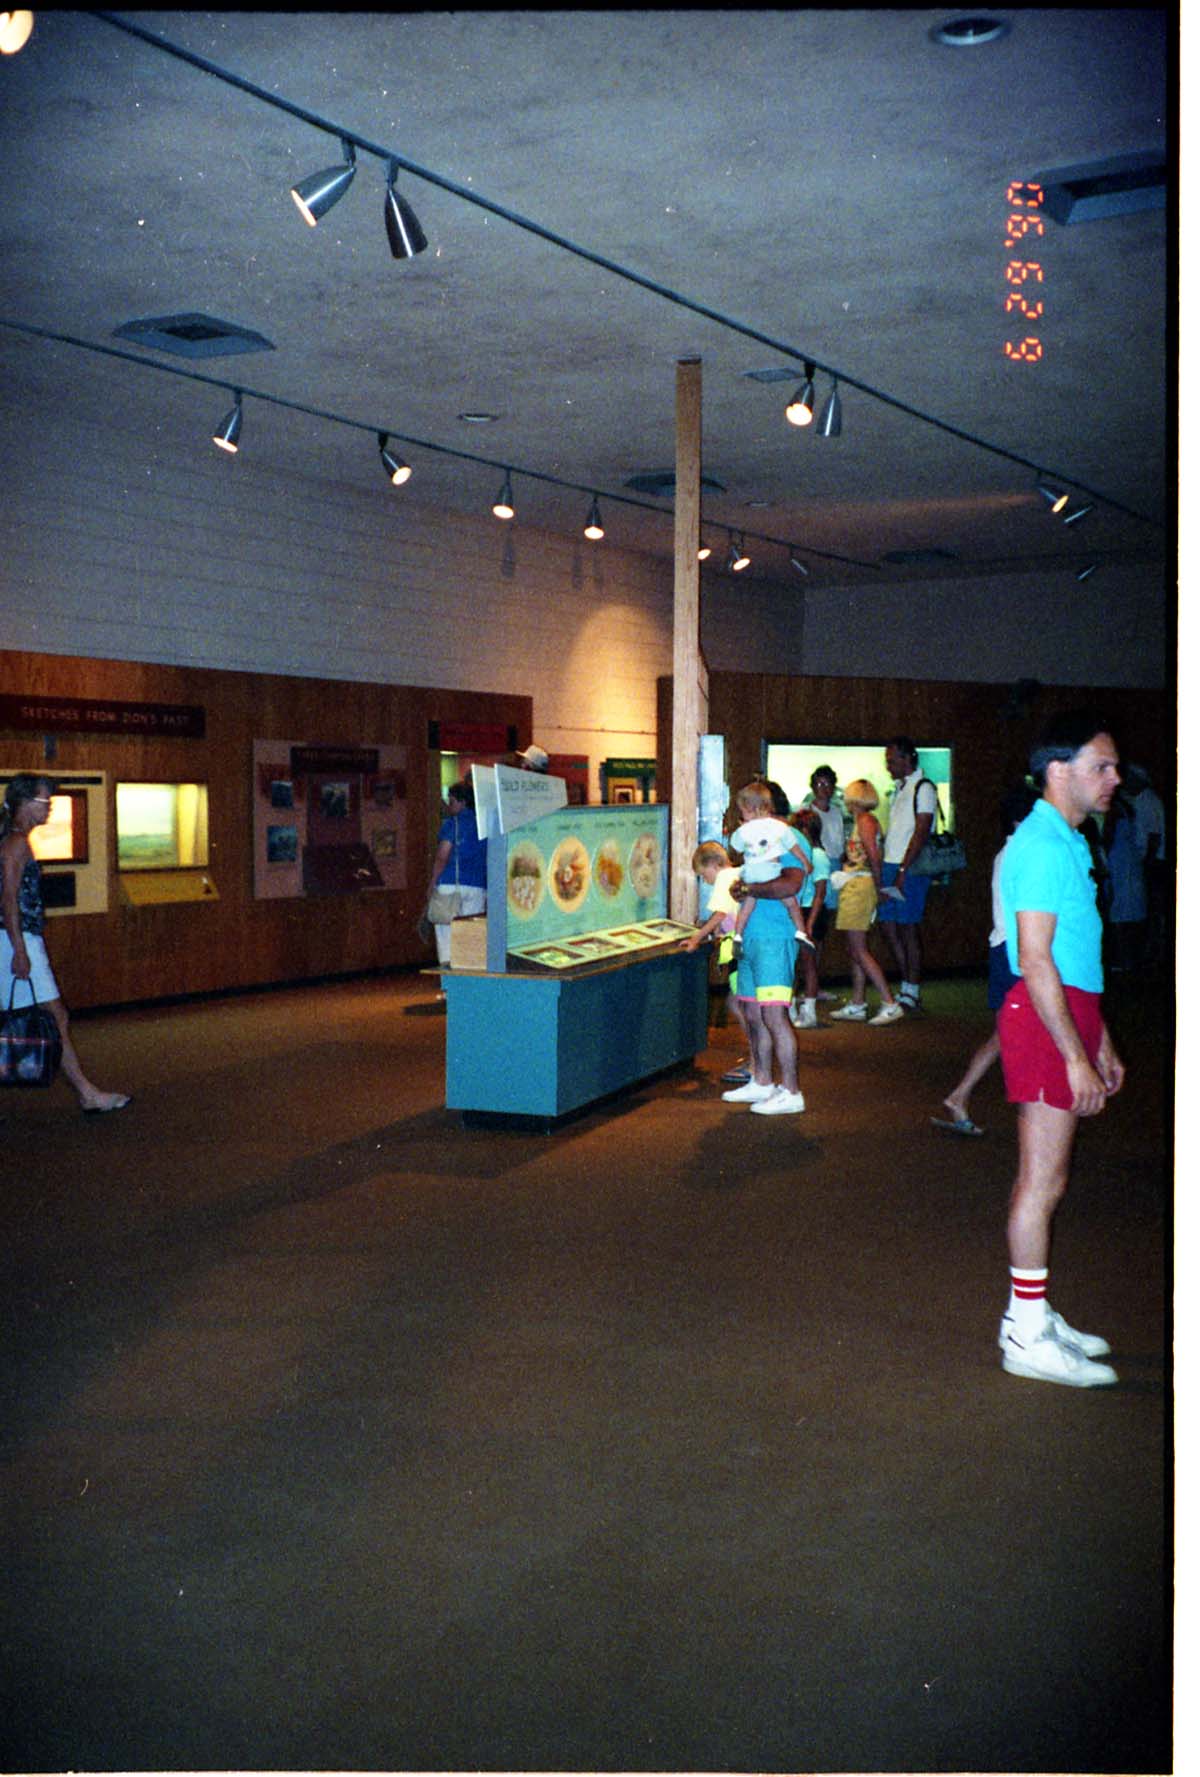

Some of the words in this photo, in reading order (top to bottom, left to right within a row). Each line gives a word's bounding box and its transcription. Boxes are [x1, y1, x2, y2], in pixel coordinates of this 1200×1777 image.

[21, 705, 80, 721] SKETCHES
[86, 709, 117, 724] FROM
[163, 715, 191, 728] PAST
